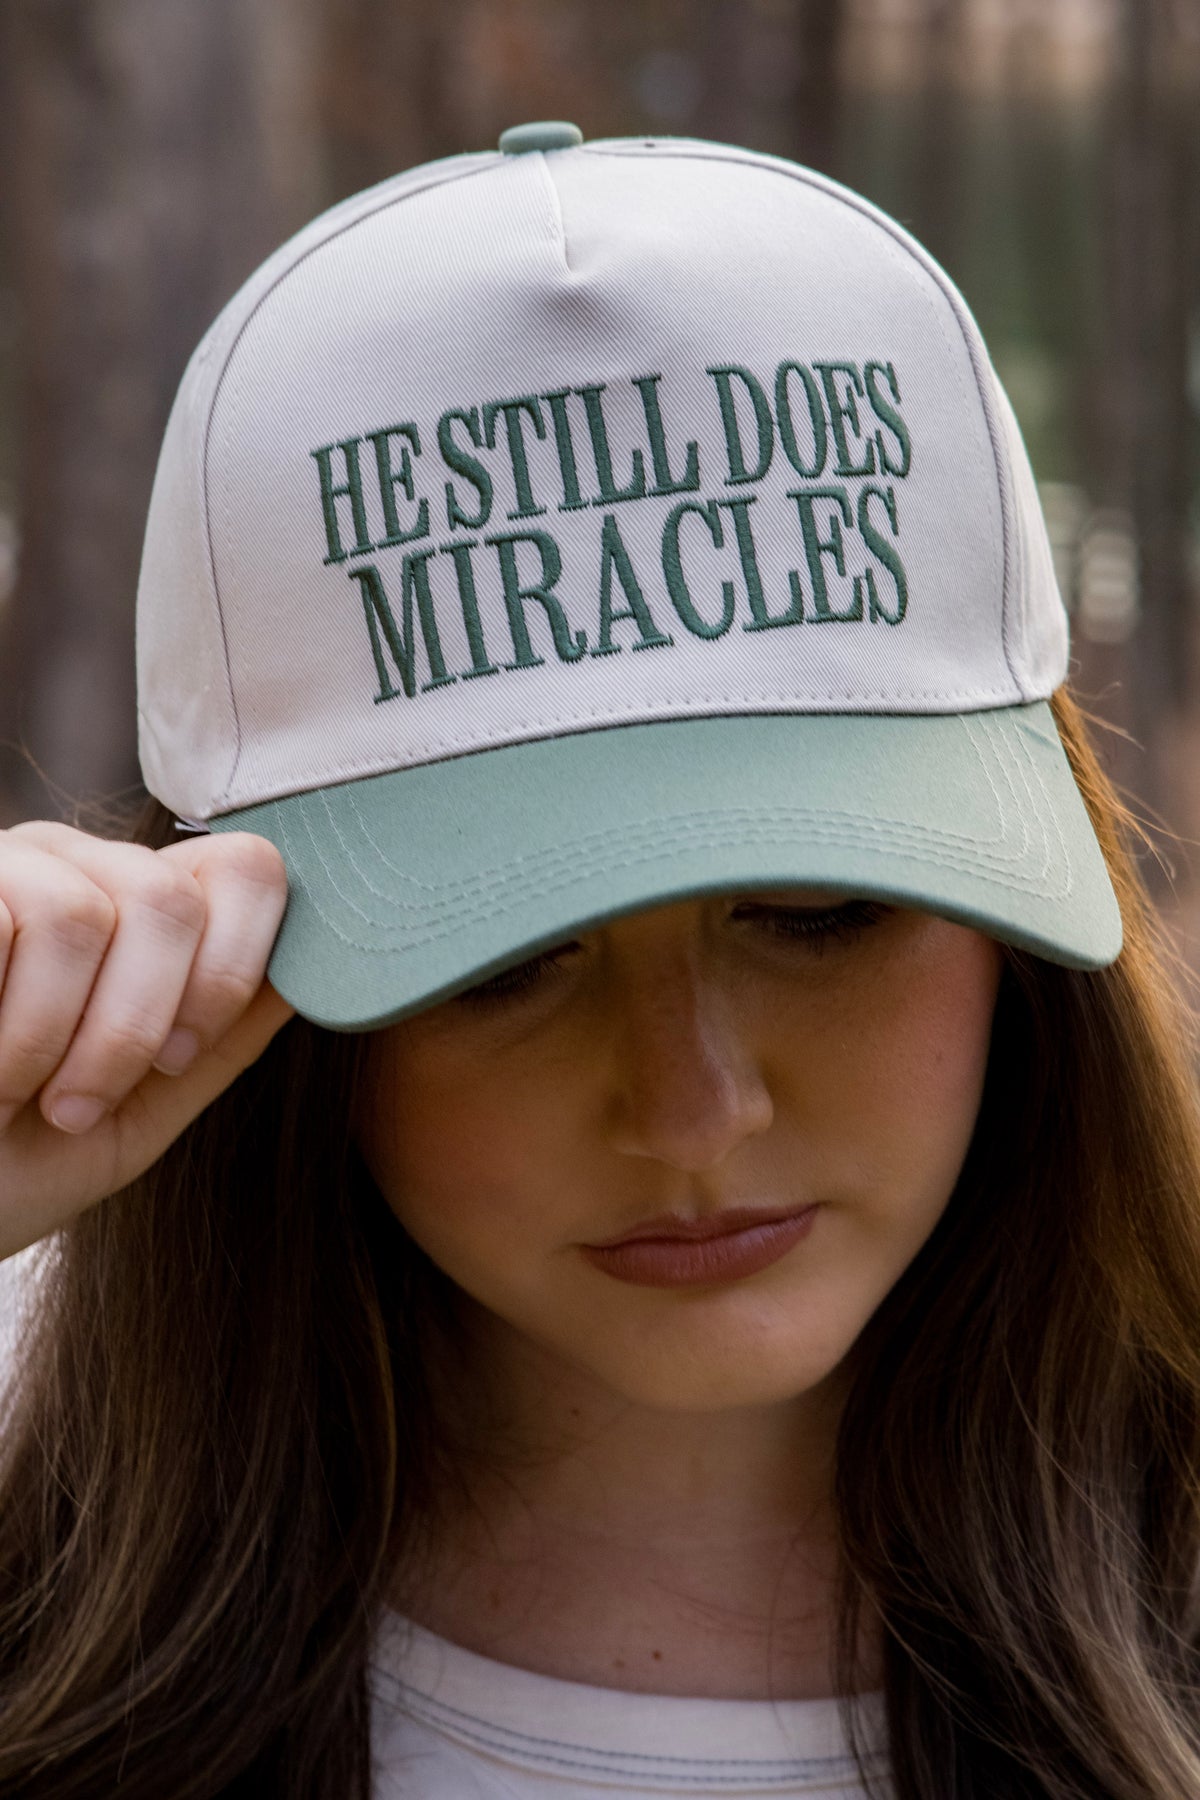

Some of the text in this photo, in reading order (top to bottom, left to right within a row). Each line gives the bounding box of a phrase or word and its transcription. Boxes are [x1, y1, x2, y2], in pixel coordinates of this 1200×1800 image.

[311, 359, 911, 566] HE STILL DOES
[348, 485, 908, 705] MIRACLES
